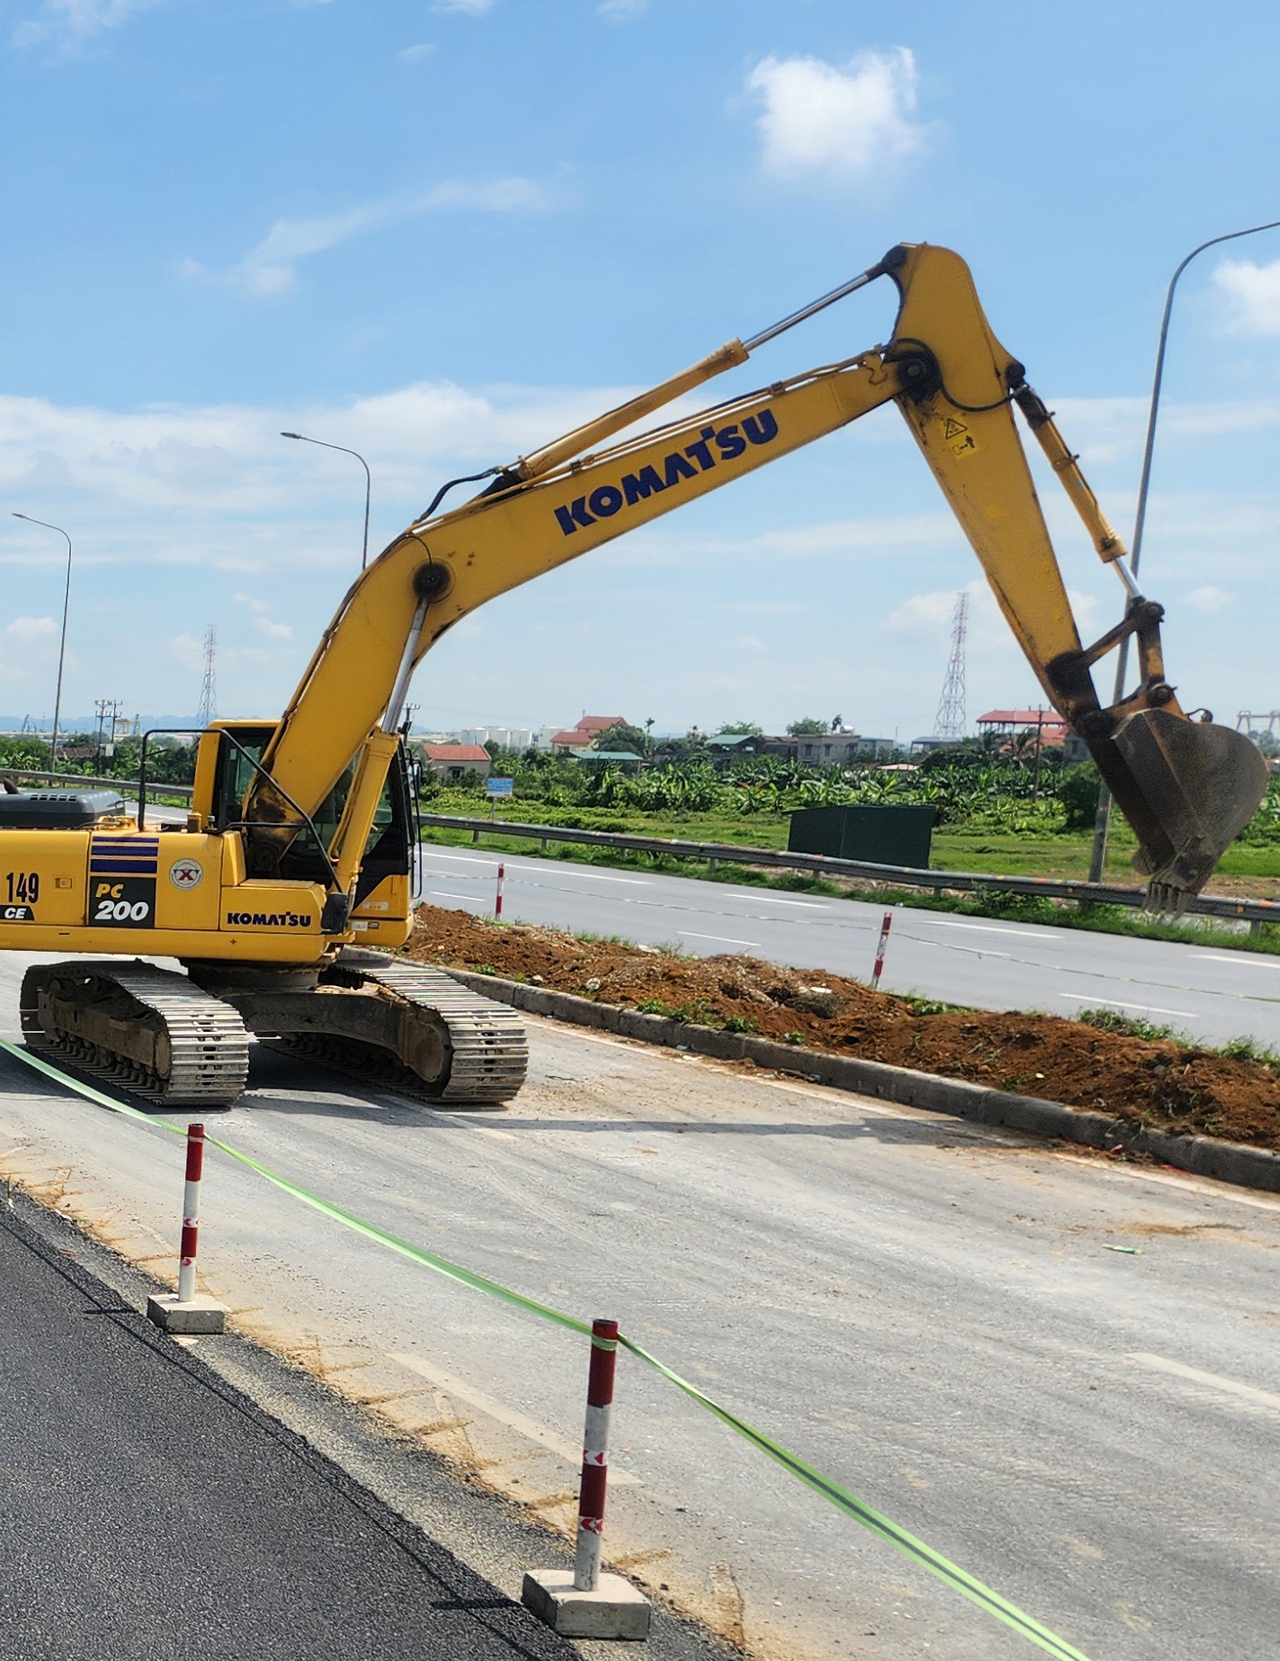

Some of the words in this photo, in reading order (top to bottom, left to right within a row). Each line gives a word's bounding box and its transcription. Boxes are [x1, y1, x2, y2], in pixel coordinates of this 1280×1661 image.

[554, 408, 779, 536] KOMATSU
[6, 872, 39, 903] 149
[95, 883, 124, 899] PC
[4, 907, 27, 919] CE
[94, 900, 149, 921] 200
[227, 911, 311, 927] KOMATSU
